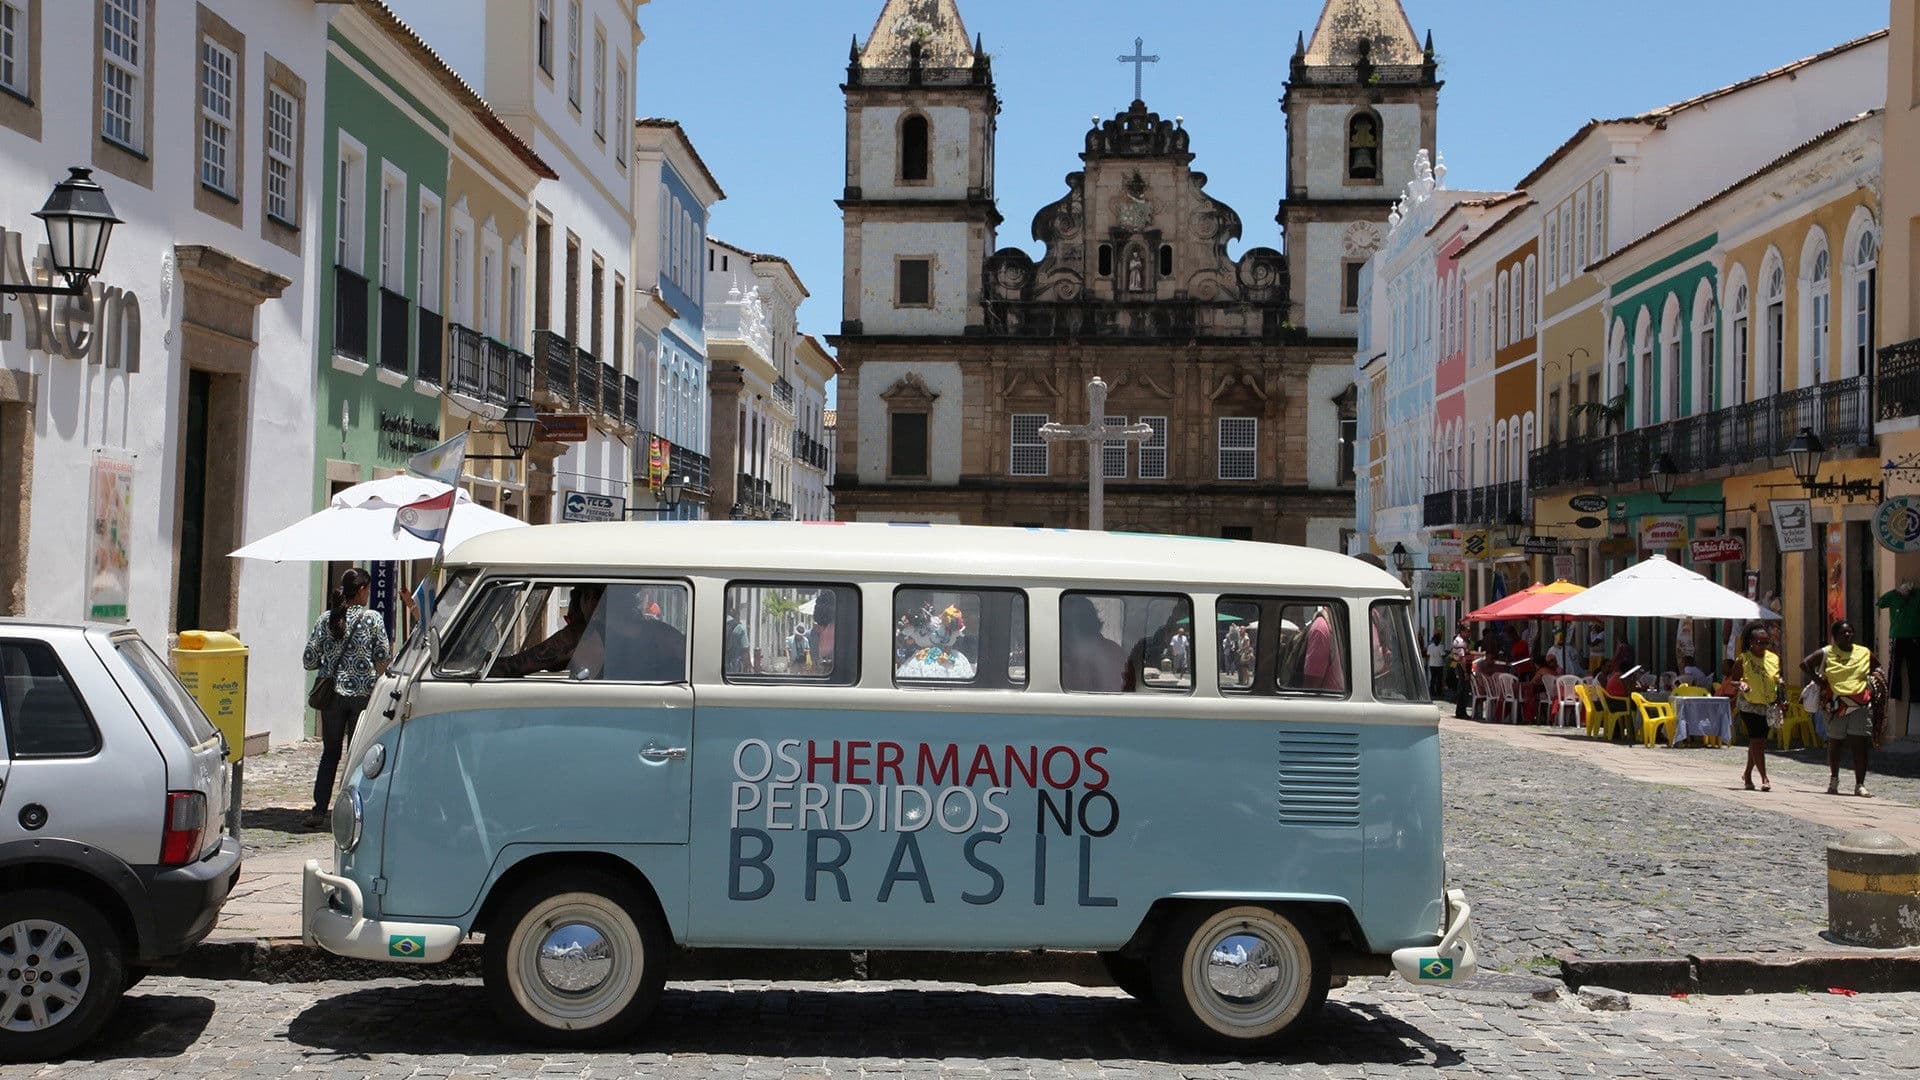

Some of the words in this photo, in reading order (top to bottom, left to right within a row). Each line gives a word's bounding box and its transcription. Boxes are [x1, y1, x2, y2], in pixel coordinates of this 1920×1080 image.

[731, 782, 1010, 834] PERDIDOS
[1037, 789, 1120, 837] NO
[728, 828, 1118, 907] BRASIL
